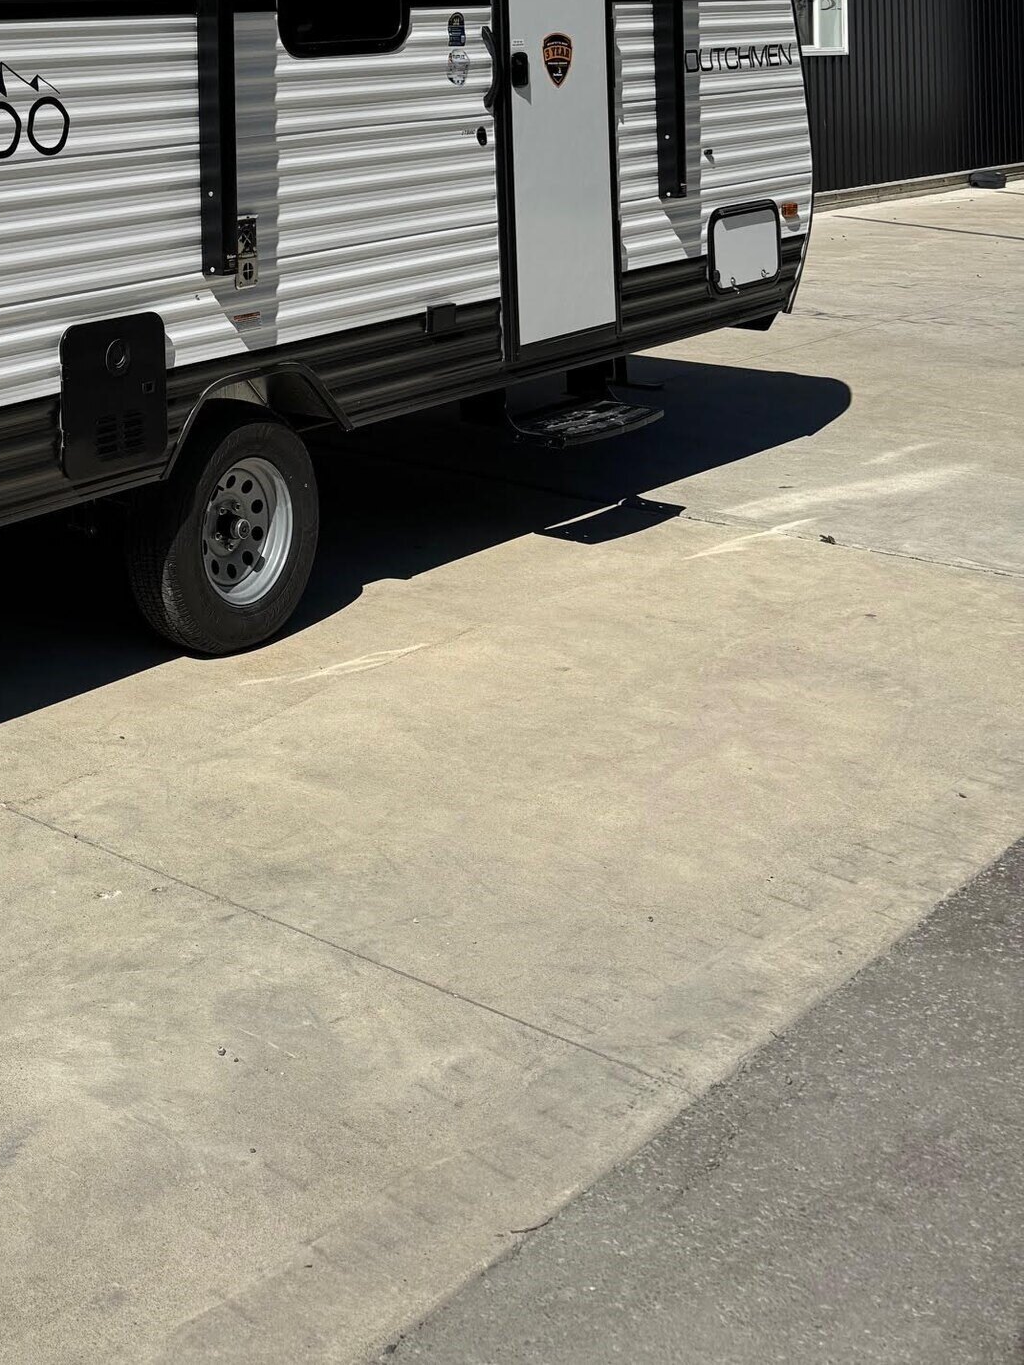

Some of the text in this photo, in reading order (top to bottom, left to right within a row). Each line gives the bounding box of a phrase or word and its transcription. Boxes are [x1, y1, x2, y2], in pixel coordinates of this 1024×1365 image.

[544, 45, 570, 60] 3 YEAR
[684, 43, 793, 74] DUTCHMEN
